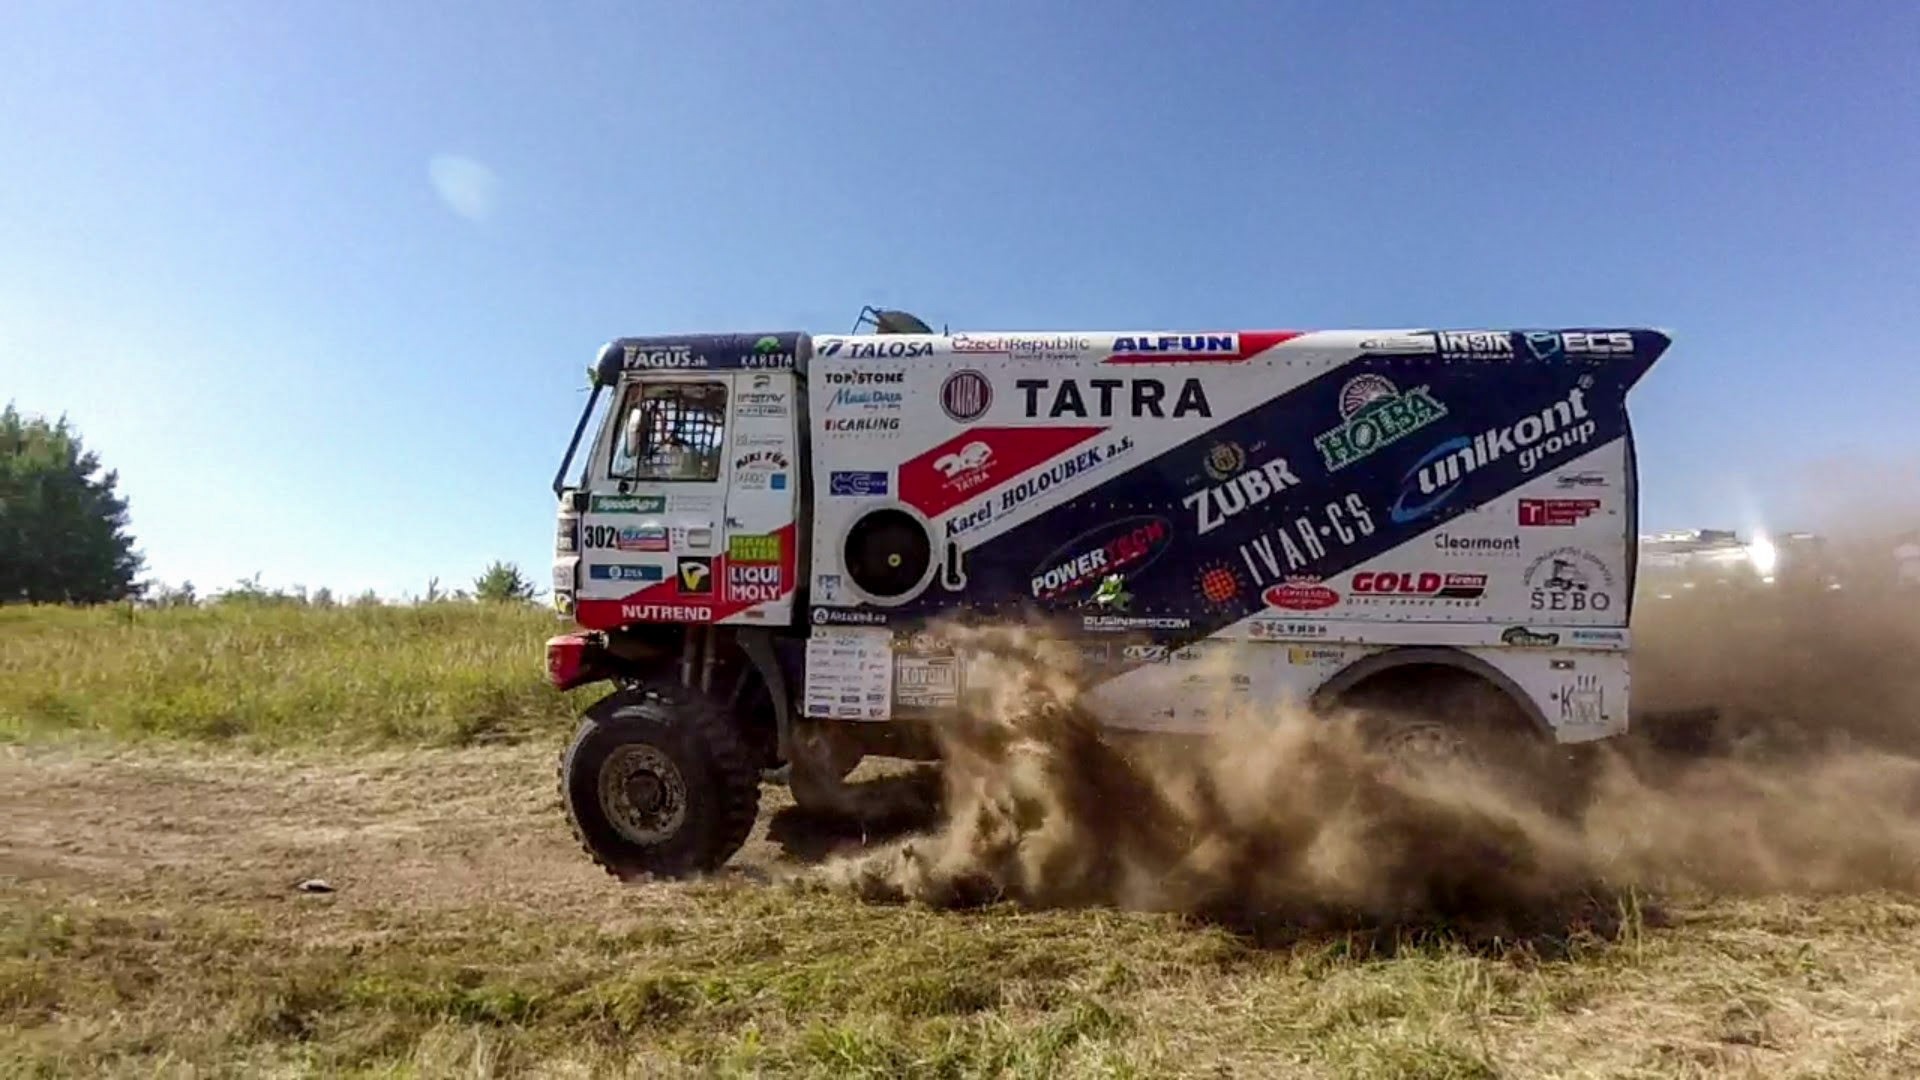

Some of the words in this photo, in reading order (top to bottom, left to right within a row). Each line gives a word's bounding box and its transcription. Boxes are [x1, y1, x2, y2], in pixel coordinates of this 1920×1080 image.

[850, 341, 935, 360] TALOSA
[1112, 335, 1233, 352] ALFUN
[1563, 332, 1634, 352] ECS
[1016, 377, 1213, 419] TATRA
[1418, 388, 1589, 495] unikont
[1519, 419, 1597, 474] group
[945, 501, 993, 539] Karel
[1001, 446, 1103, 511] HOLOUBEK
[1106, 435, 1134, 459] a.s.
[1181, 456, 1301, 536] ZUBR
[584, 524, 617, 550] 302
[731, 537, 779, 548] MANN
[1434, 532, 1521, 550] Clearmont
[731, 548, 779, 560] FILTER
[731, 566, 780, 583] LIQUI
[1352, 571, 1442, 593] GOLD
[731, 584, 780, 602] MOLY
[1530, 587, 1611, 611] ŠEBO
[621, 604, 713, 622] NUTREND
